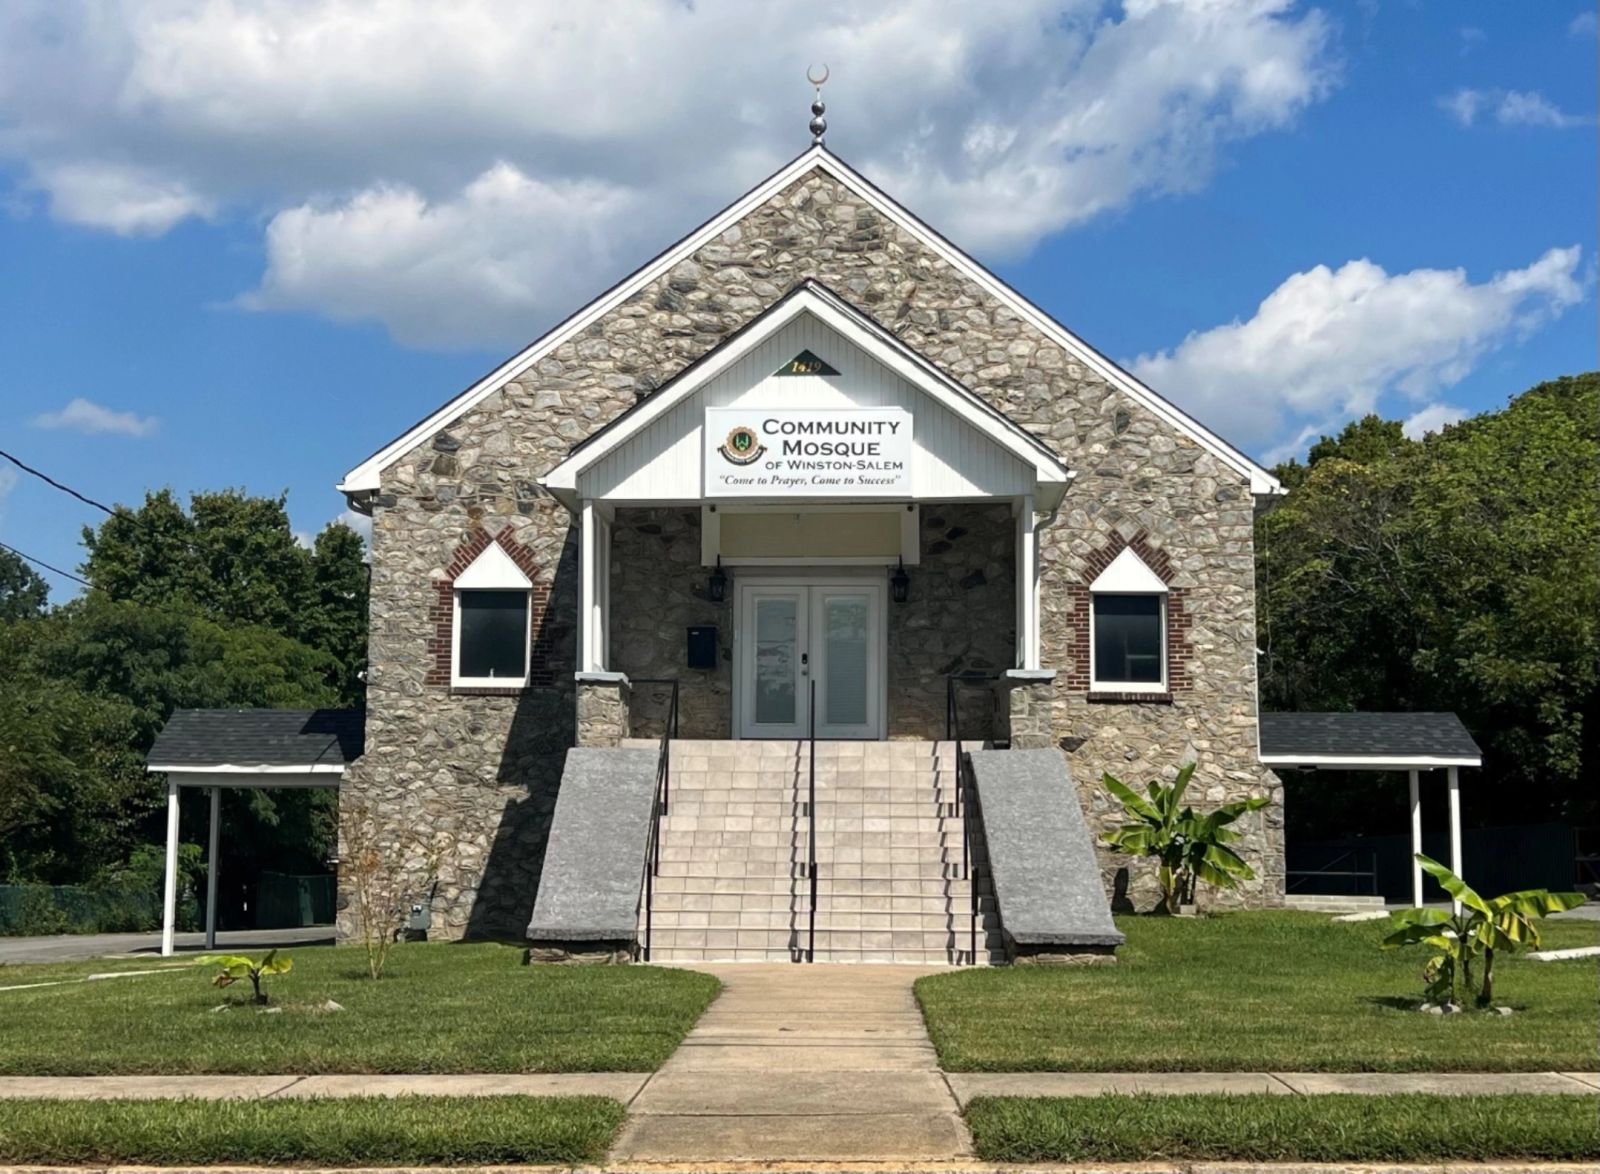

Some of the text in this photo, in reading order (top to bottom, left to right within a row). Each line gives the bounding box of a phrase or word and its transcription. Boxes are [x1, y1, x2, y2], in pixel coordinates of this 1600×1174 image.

[762, 418, 900, 435] COMMUNITY
[782, 439, 881, 457] MOSQUE
[765, 459, 904, 470] OF WINSTON-SALEM
[757, 476, 767, 485] to
[770, 474, 808, 489] Prayer,
[811, 474, 841, 485] Come
[843, 476, 854, 485] to
